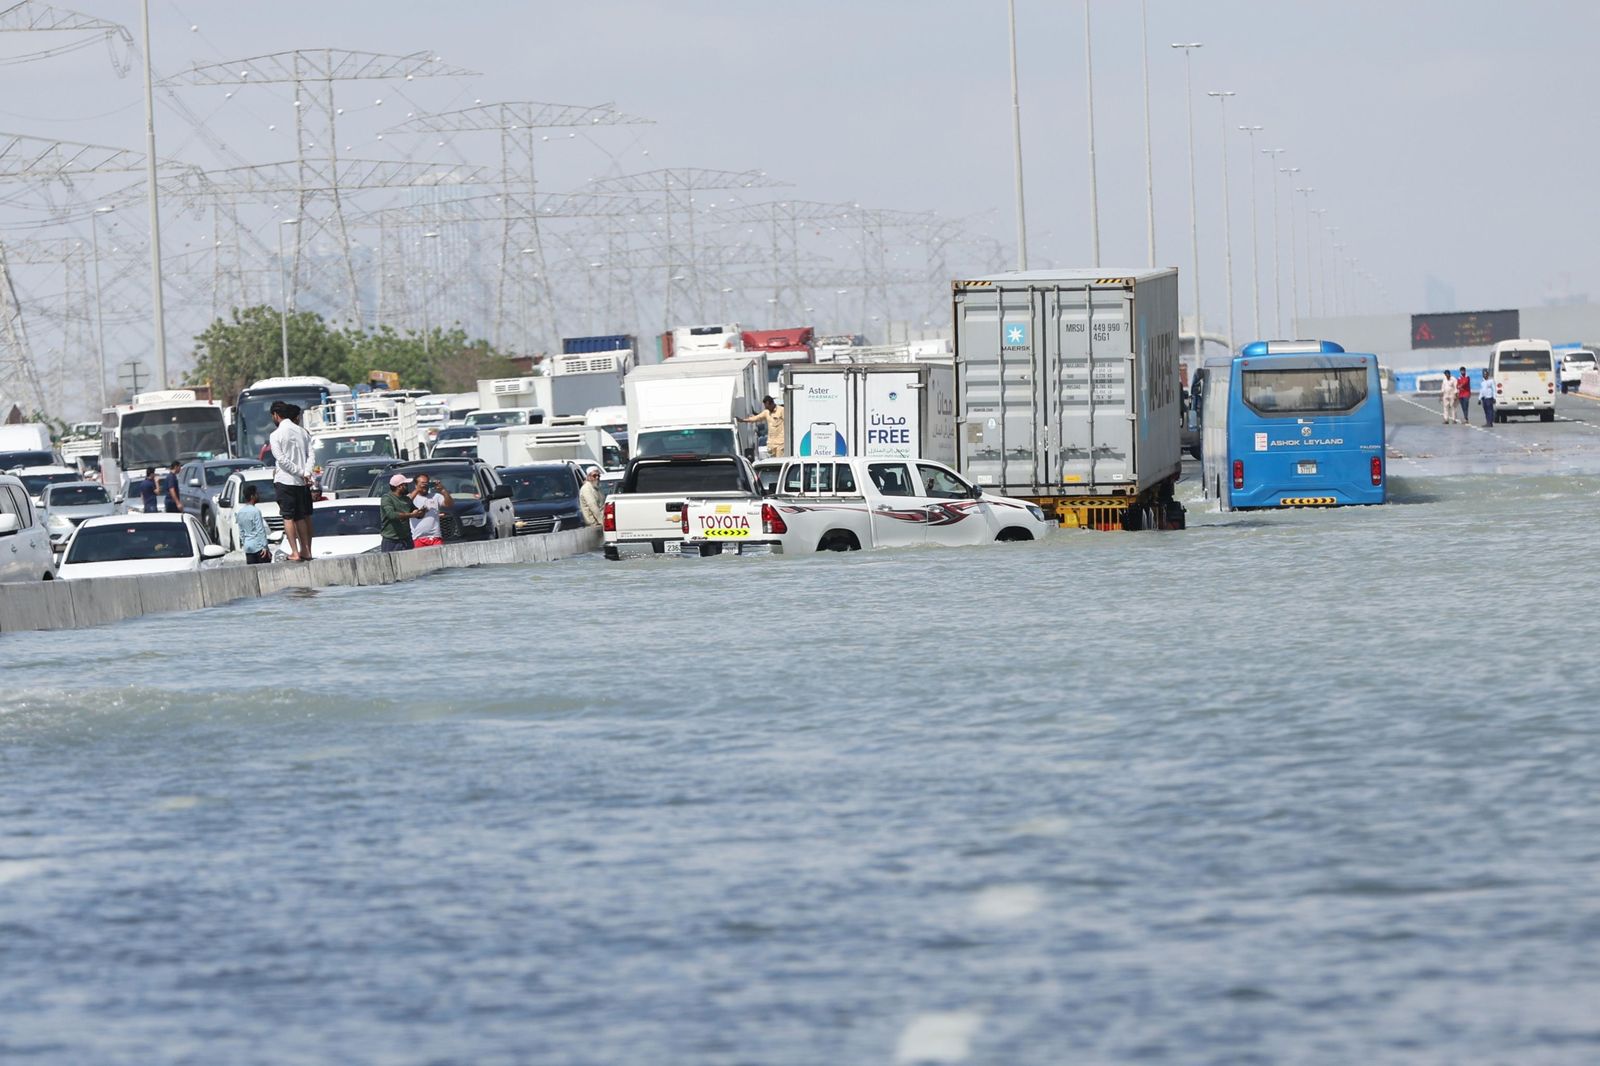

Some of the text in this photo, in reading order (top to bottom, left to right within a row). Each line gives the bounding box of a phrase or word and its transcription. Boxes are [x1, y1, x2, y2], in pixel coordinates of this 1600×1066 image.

[1066, 322, 1129, 333] MRSU 449 990 7
[1093, 332, 1110, 341] 45G1
[868, 429, 910, 443] FREE
[698, 515, 750, 528] TOYOTA
